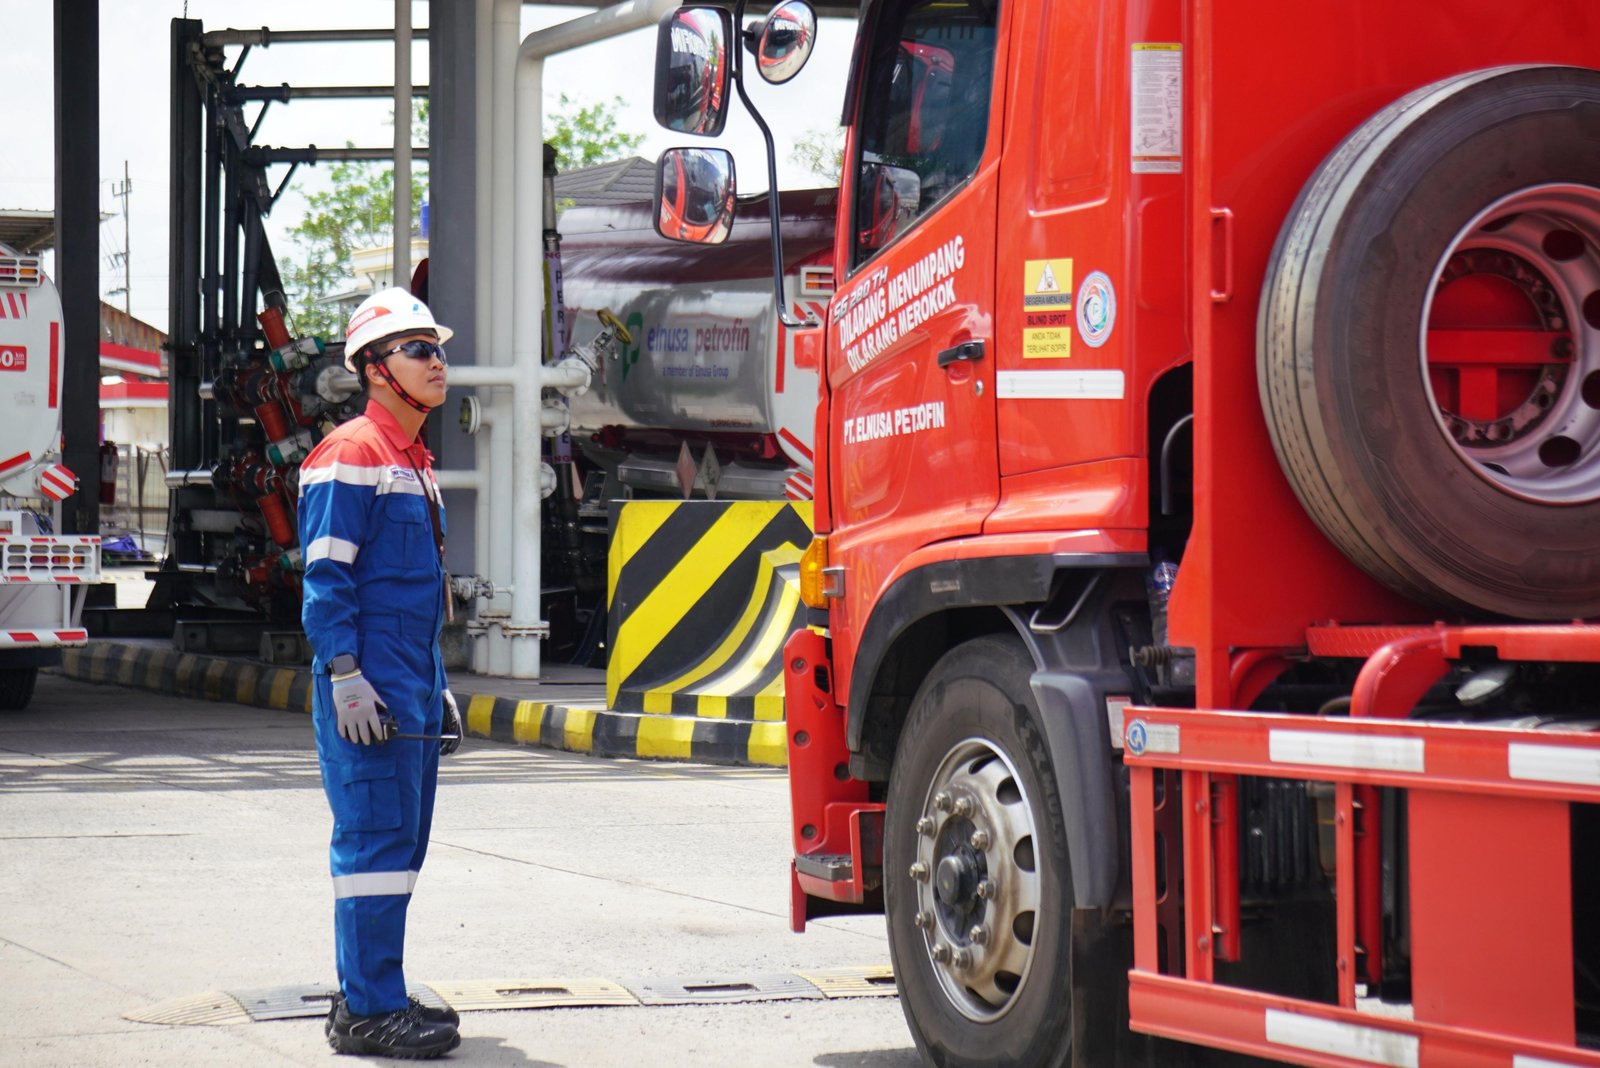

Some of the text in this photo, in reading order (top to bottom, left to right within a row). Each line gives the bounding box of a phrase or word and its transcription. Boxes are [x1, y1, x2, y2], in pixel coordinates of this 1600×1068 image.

[840, 235, 965, 350] DILARANG MENUMPANG
[849, 279, 871, 309] 280
[871, 266, 889, 290] TH
[647, 317, 750, 356] elnusa petrofin
[847, 277, 956, 374] DILARANG MEROKOK
[1048, 314, 1067, 325] SPOT
[0, 350, 14, 368] 0
[844, 419, 856, 446] PT.
[856, 411, 893, 443] ELNUSA
